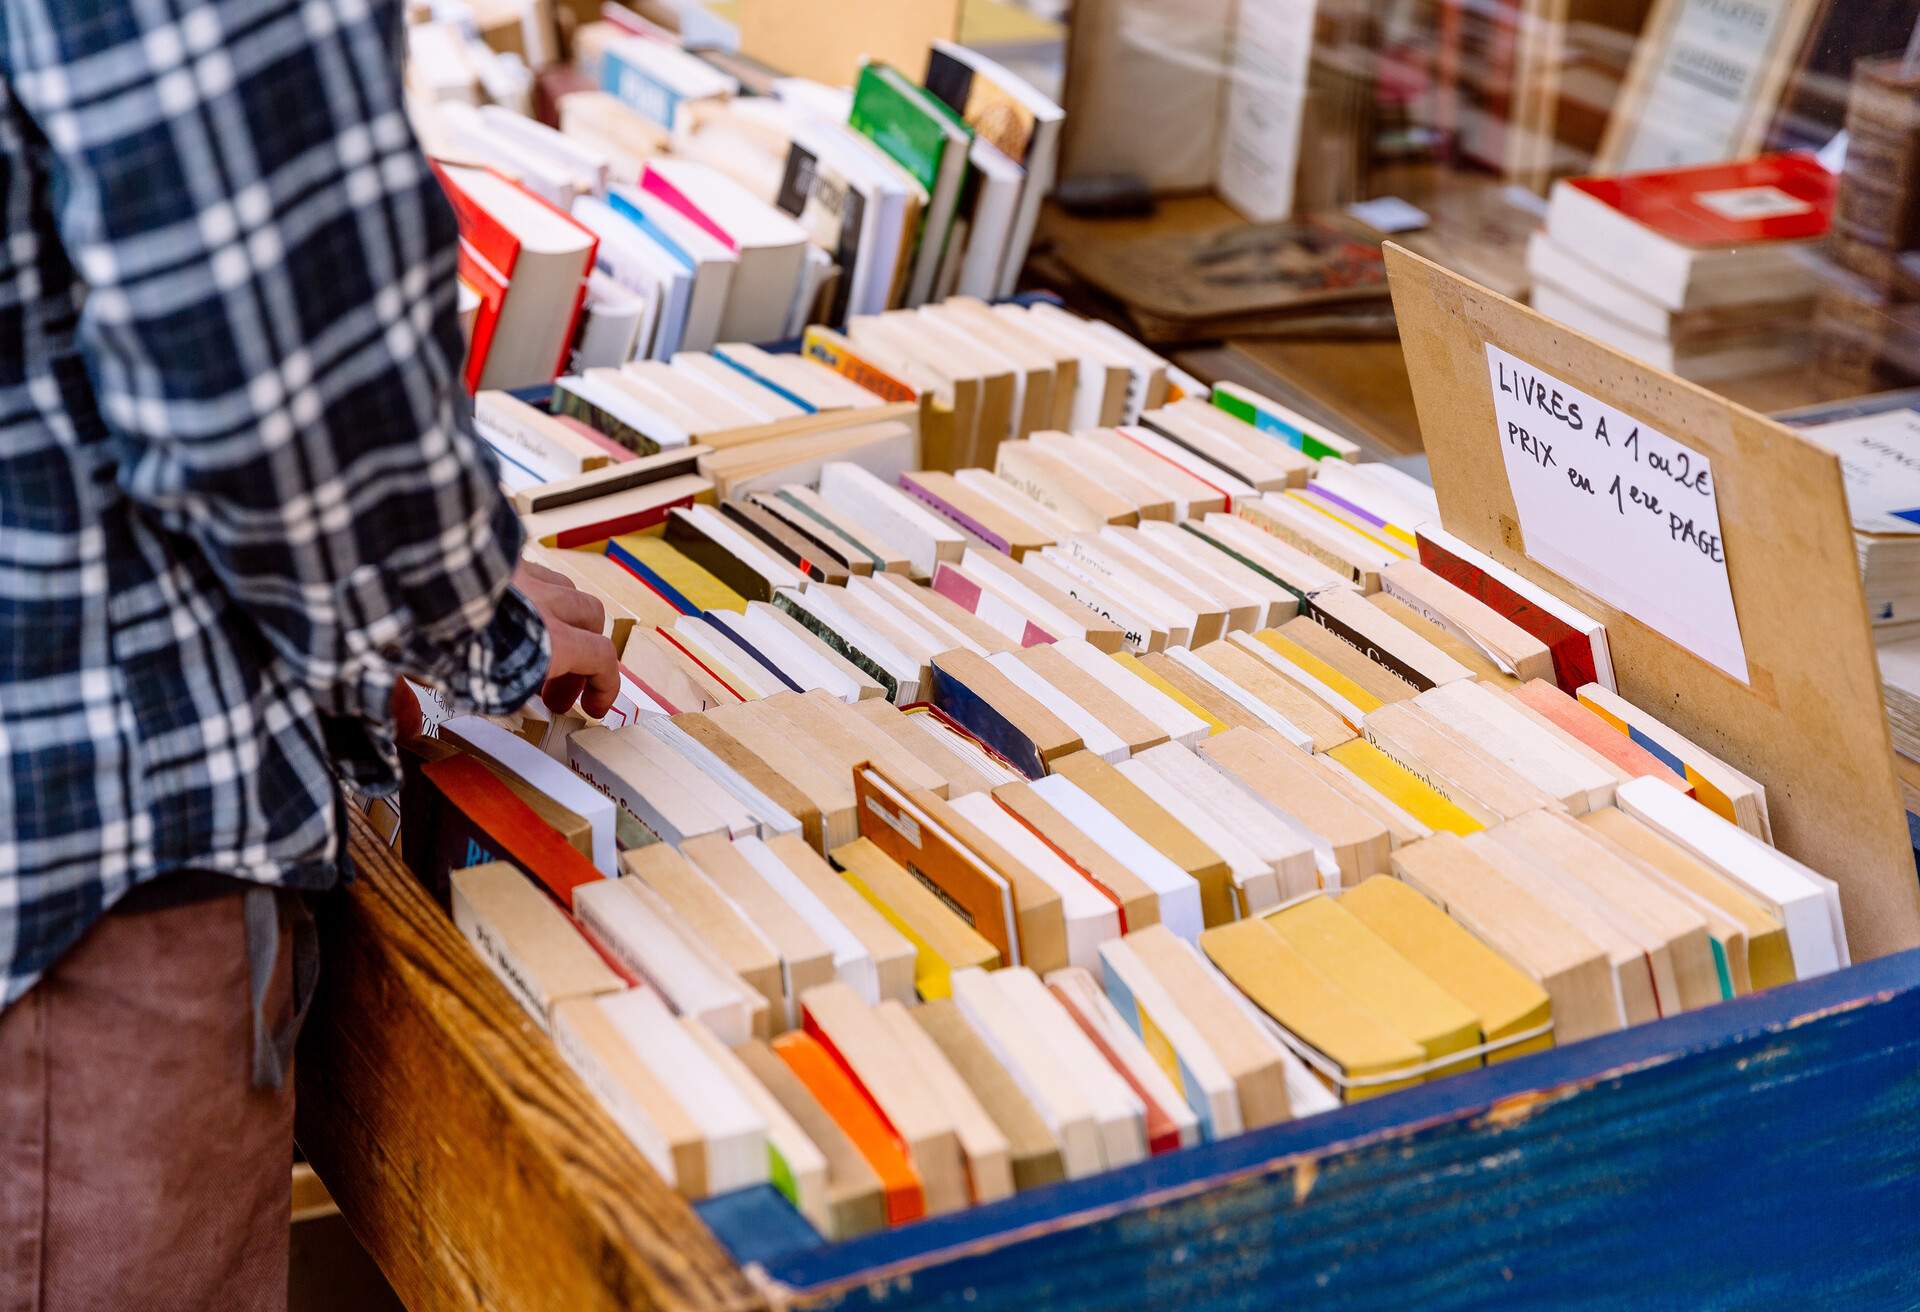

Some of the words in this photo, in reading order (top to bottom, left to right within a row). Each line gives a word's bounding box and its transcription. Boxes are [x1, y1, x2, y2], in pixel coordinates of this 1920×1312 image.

[1499, 362, 1584, 430] LIVRES
[1595, 416, 1611, 447] A
[1624, 427, 1639, 462] 1
[1508, 421, 1557, 467] PRIX
[1567, 468, 1595, 495] en
[1669, 512, 1724, 563] PAGE
